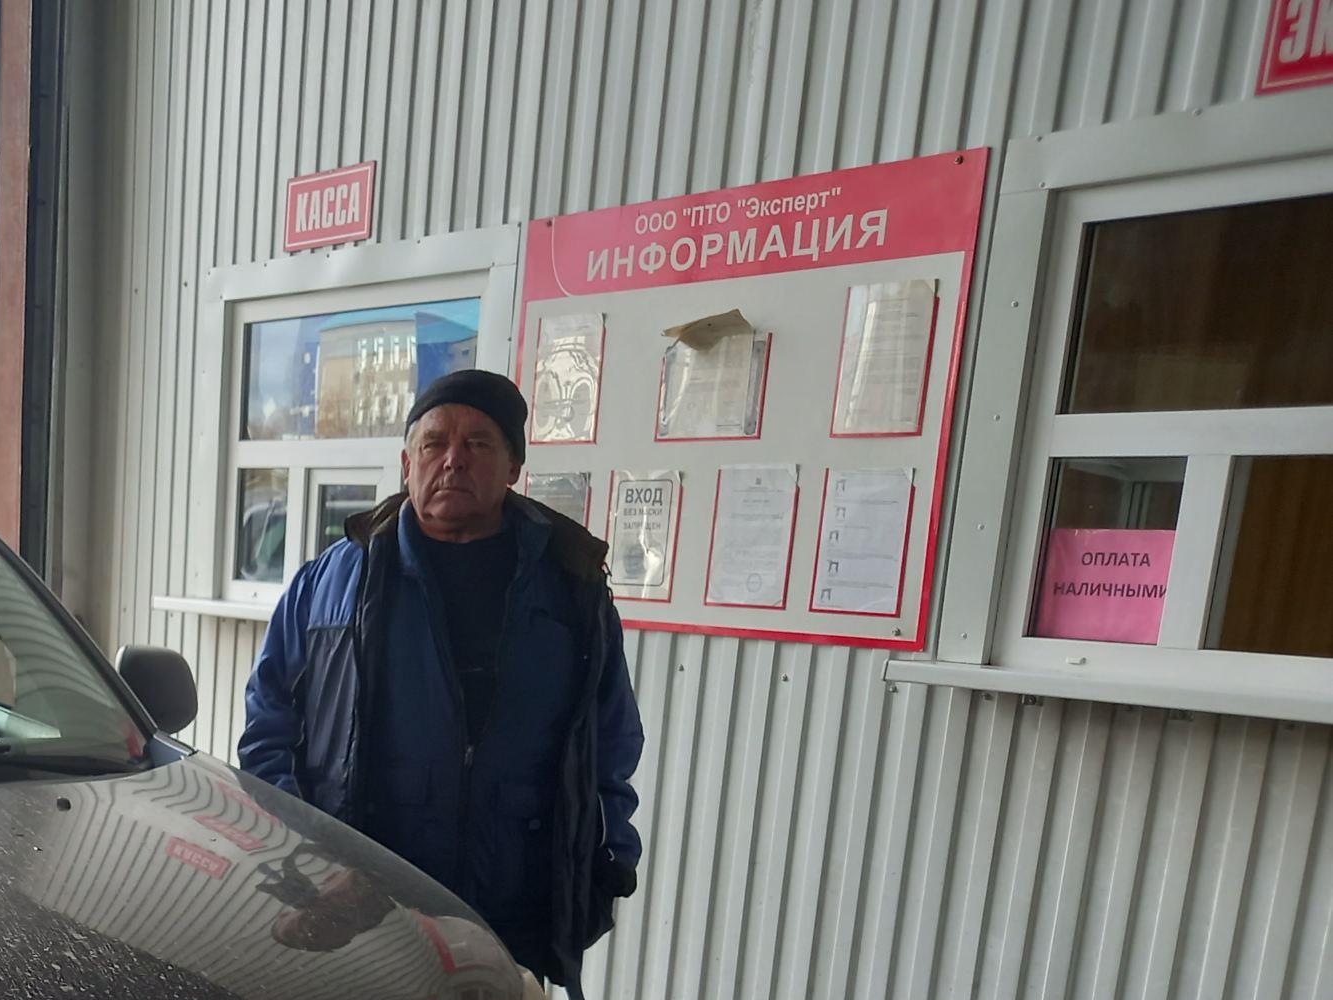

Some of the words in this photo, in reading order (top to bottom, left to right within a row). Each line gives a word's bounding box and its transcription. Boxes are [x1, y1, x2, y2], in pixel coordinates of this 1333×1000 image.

[295, 181, 360, 233] КАССА
[635, 210, 677, 235] ООО
[683, 201, 731, 228] "ПТО
[737, 186, 842, 219] "Эксперт"
[586, 208, 888, 283] ИНФОРМАЦИЯ
[625, 488, 663, 506] ВХОД
[1081, 551, 1151, 567] ОПЛАТА
